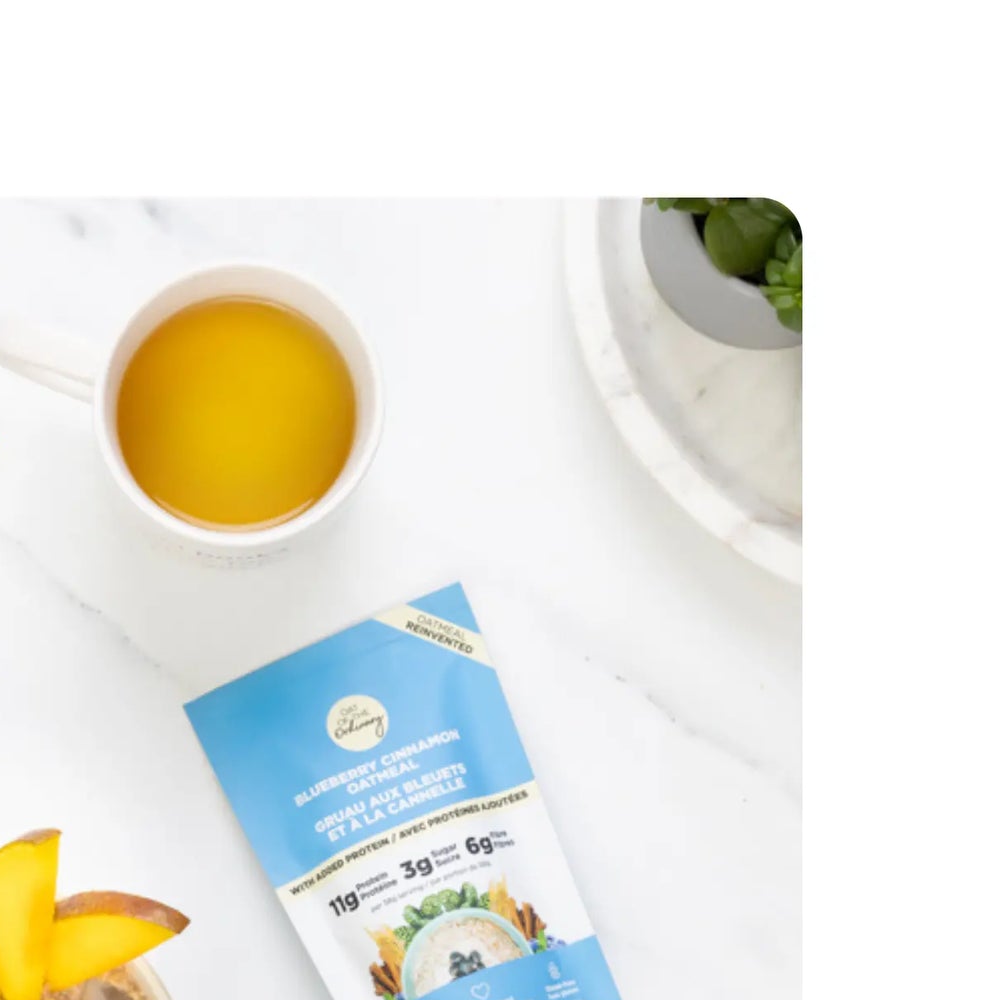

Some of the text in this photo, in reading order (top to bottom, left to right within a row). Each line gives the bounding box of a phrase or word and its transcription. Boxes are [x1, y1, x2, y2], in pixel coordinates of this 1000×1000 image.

[405, 620, 474, 654] REINVENTED
[416, 614, 466, 641] OATMEAL
[294, 728, 462, 807] BLUEBERRY CINNAMON
[346, 758, 420, 795] OATMEAL
[314, 762, 468, 833] GRUAU AUX BLEUETS
[326, 776, 466, 842] ET À LA CANNELLE
[288, 788, 529, 897] WITH ADDED PROTEIN / AVEC PROTÉINES AJOUTÉES
[465, 836, 494, 856] 6g
[355, 870, 388, 894] Protein
[399, 856, 434, 880] 3g
[328, 889, 360, 917] 11g
[359, 878, 398, 902] Protéine
